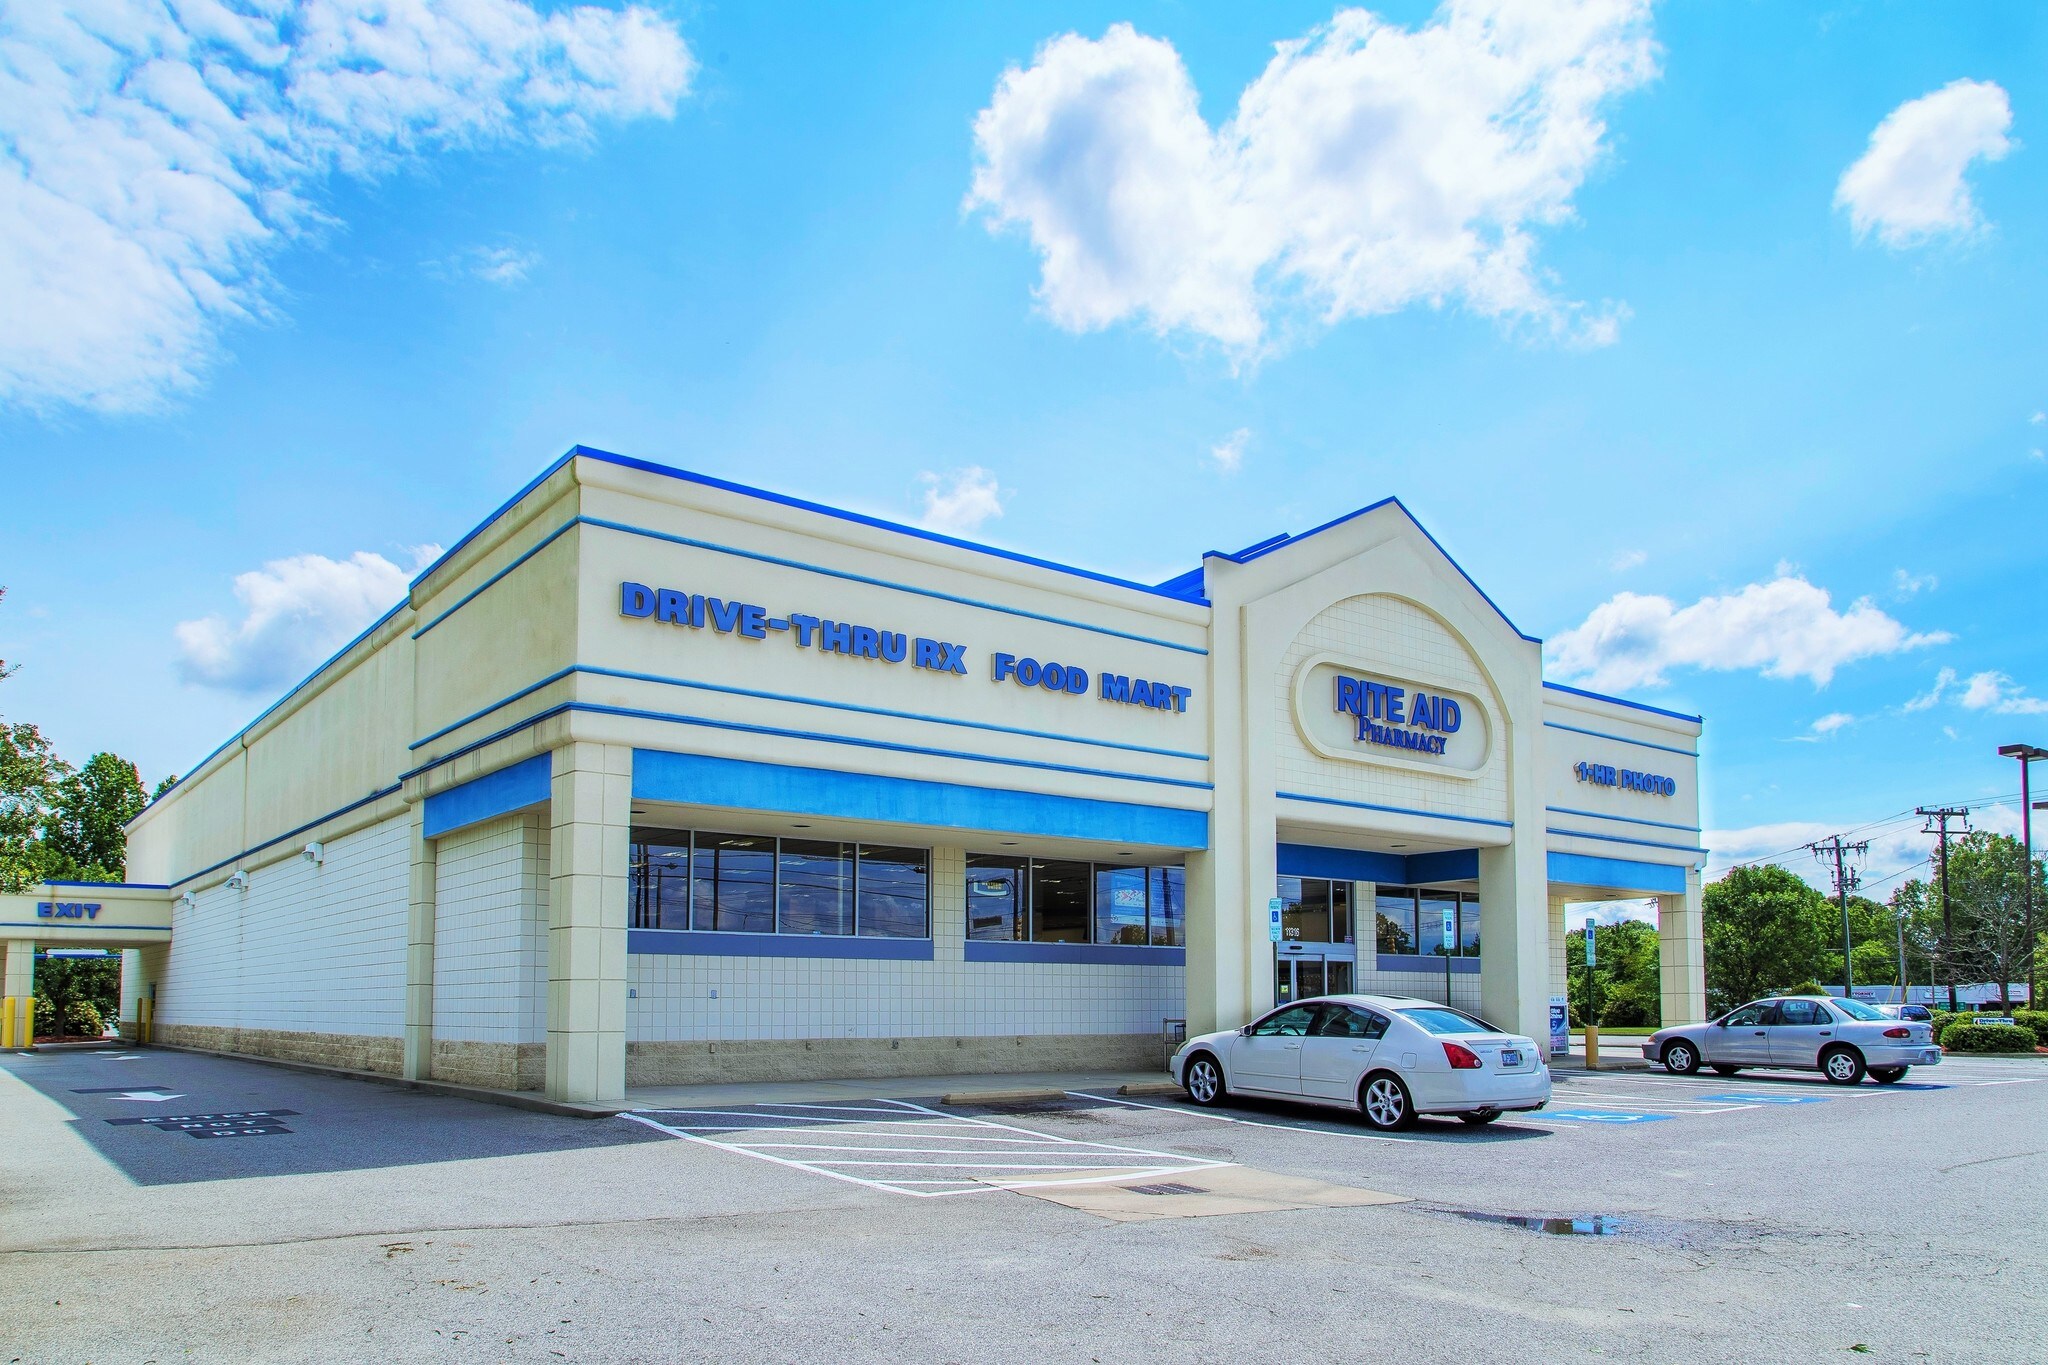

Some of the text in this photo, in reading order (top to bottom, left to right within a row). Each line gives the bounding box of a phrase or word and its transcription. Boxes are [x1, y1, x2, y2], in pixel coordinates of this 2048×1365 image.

[619, 581, 1192, 713] DRIVE-THRU RX FOOD MART
[1334, 675, 1462, 733] RITE AID
[1354, 715, 1448, 755] PHARMACY
[1575, 761, 1676, 797] 1-HR PHOTO
[37, 901, 102, 919] EXIT
[141, 1111, 270, 1122] ENTER
[180, 1120, 256, 1129] NOT
[212, 1128, 266, 1136] DO
